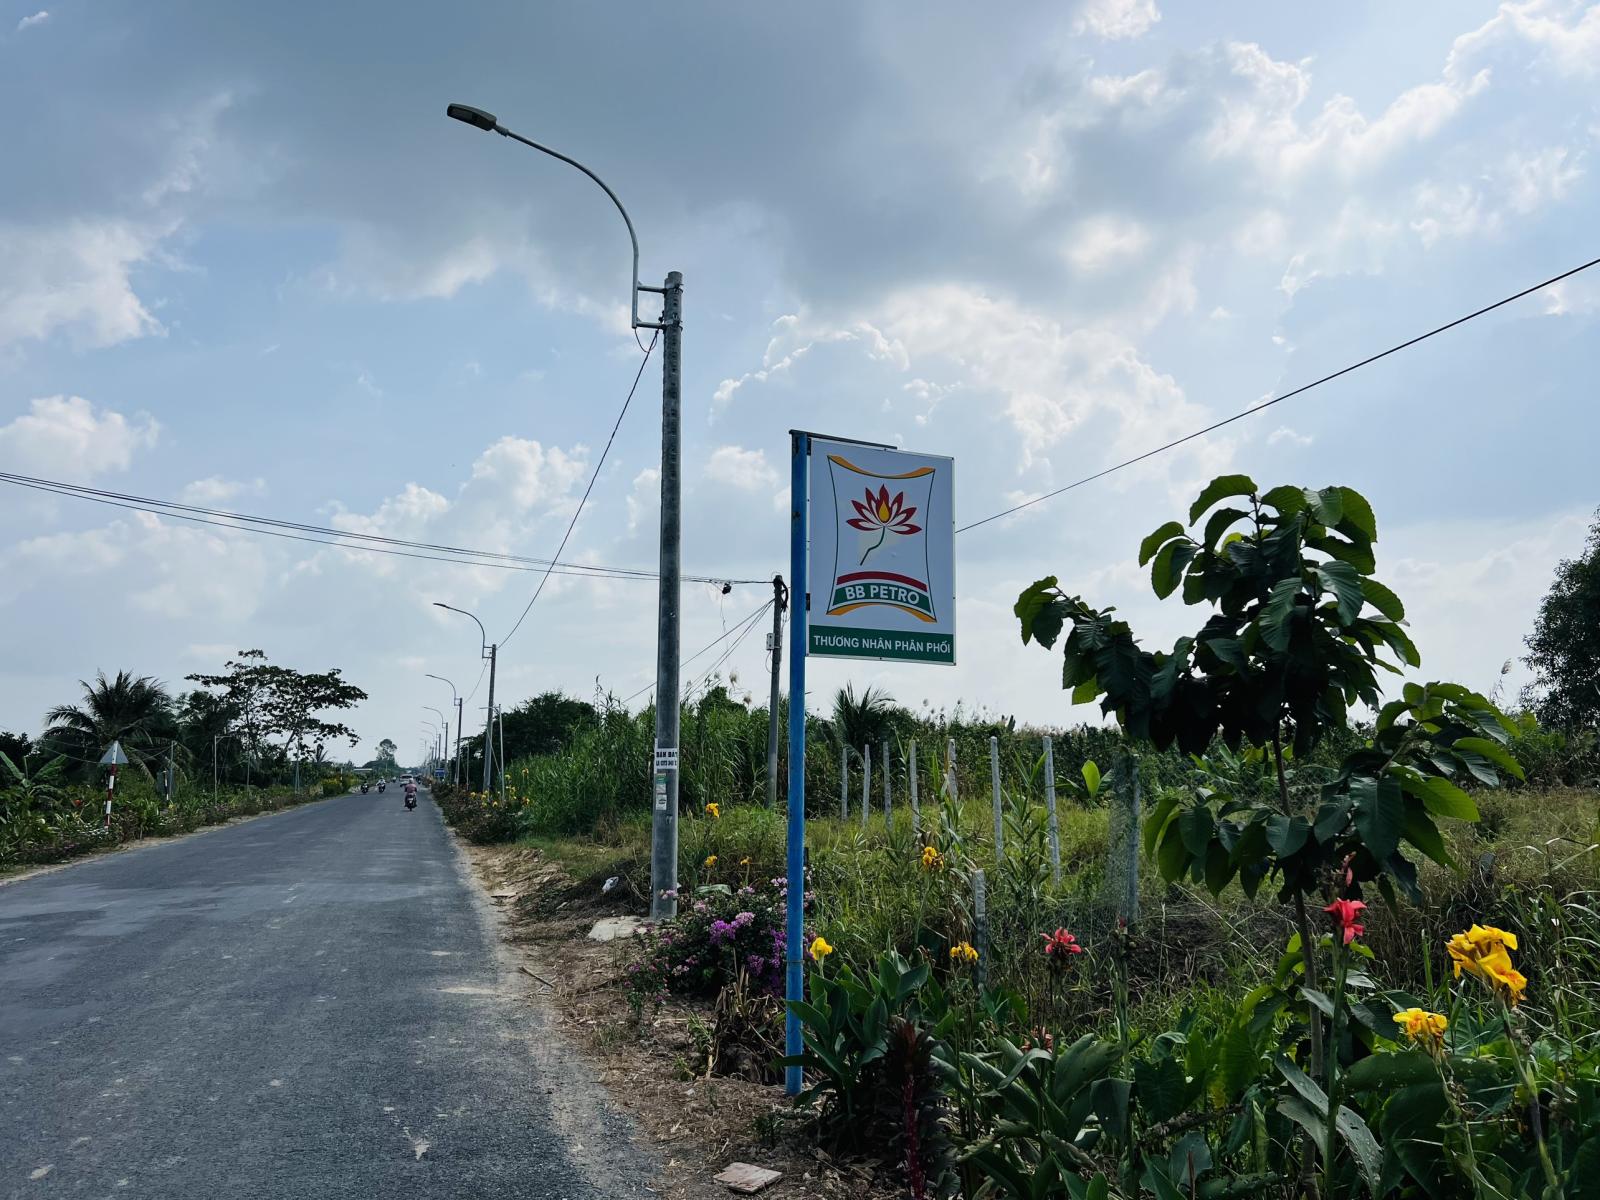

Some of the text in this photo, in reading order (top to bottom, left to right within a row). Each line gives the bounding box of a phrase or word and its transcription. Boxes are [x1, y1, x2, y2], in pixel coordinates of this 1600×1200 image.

[845, 584, 920, 605] BB PETRO
[813, 634, 951, 653] THƯƠNG NHÂN PHÂN PHỐI
